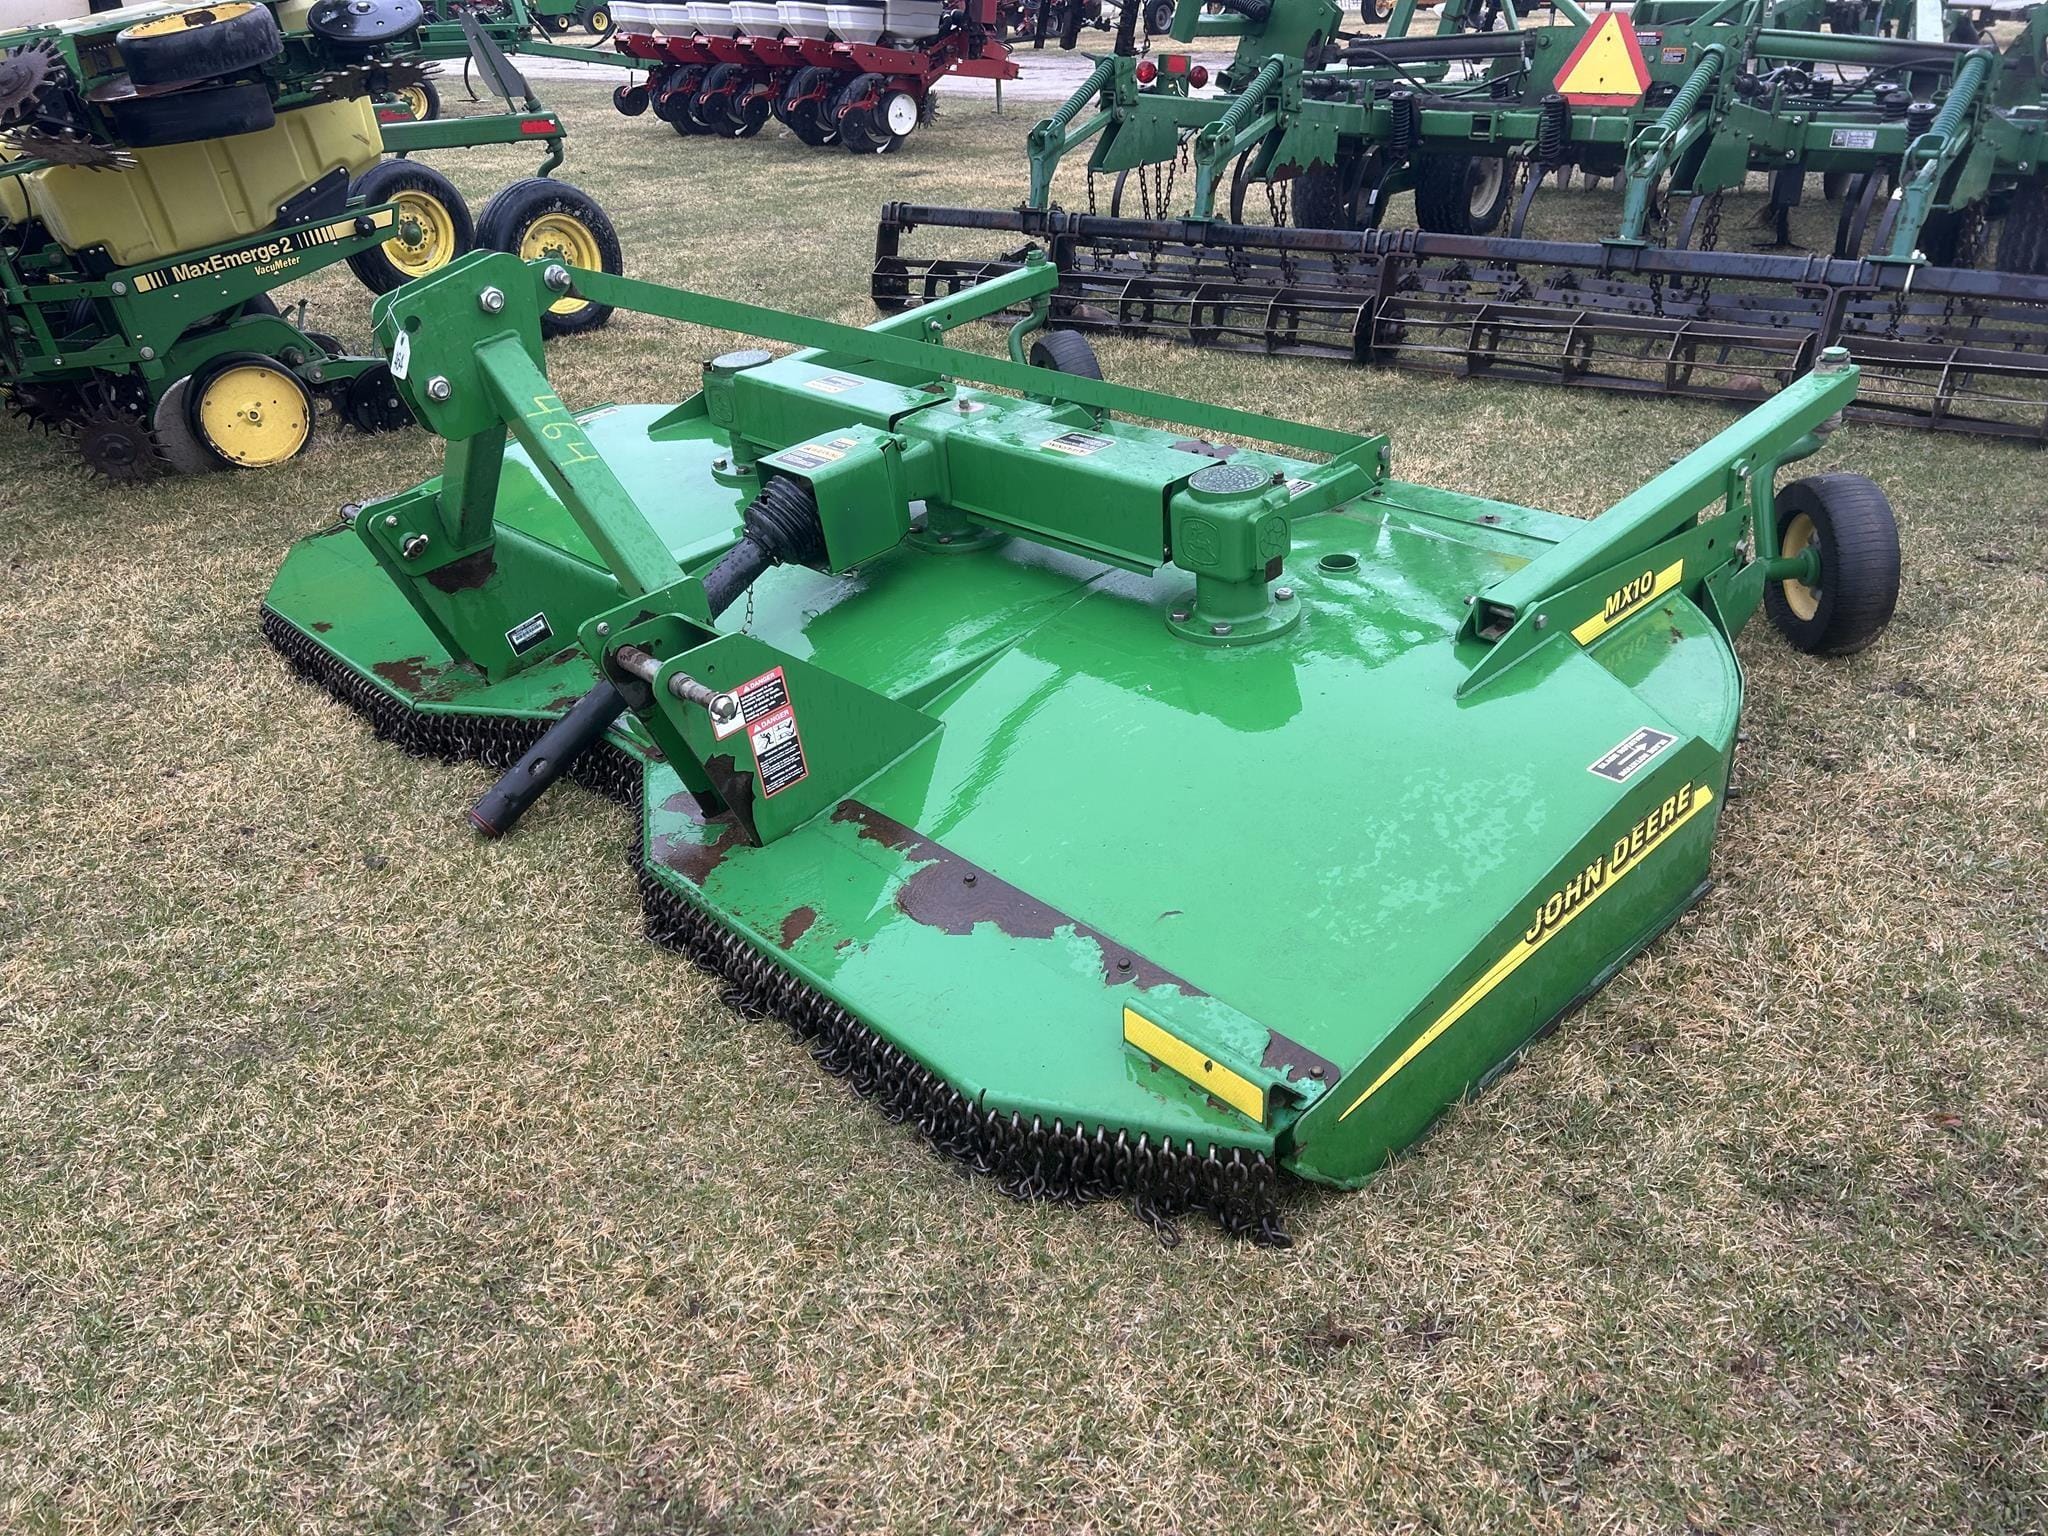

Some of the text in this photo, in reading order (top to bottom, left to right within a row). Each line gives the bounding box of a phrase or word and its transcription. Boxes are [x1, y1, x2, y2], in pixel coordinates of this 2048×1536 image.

[171, 237, 294, 283] MaxEmerge 2
[254, 255, 301, 277] VacuMeter
[526, 395, 599, 466] 464
[1604, 570, 1655, 621] MX10
[749, 672, 776, 689] DANGER
[760, 709, 790, 728] DANGER
[1525, 781, 1694, 943] JOHN DEERE
